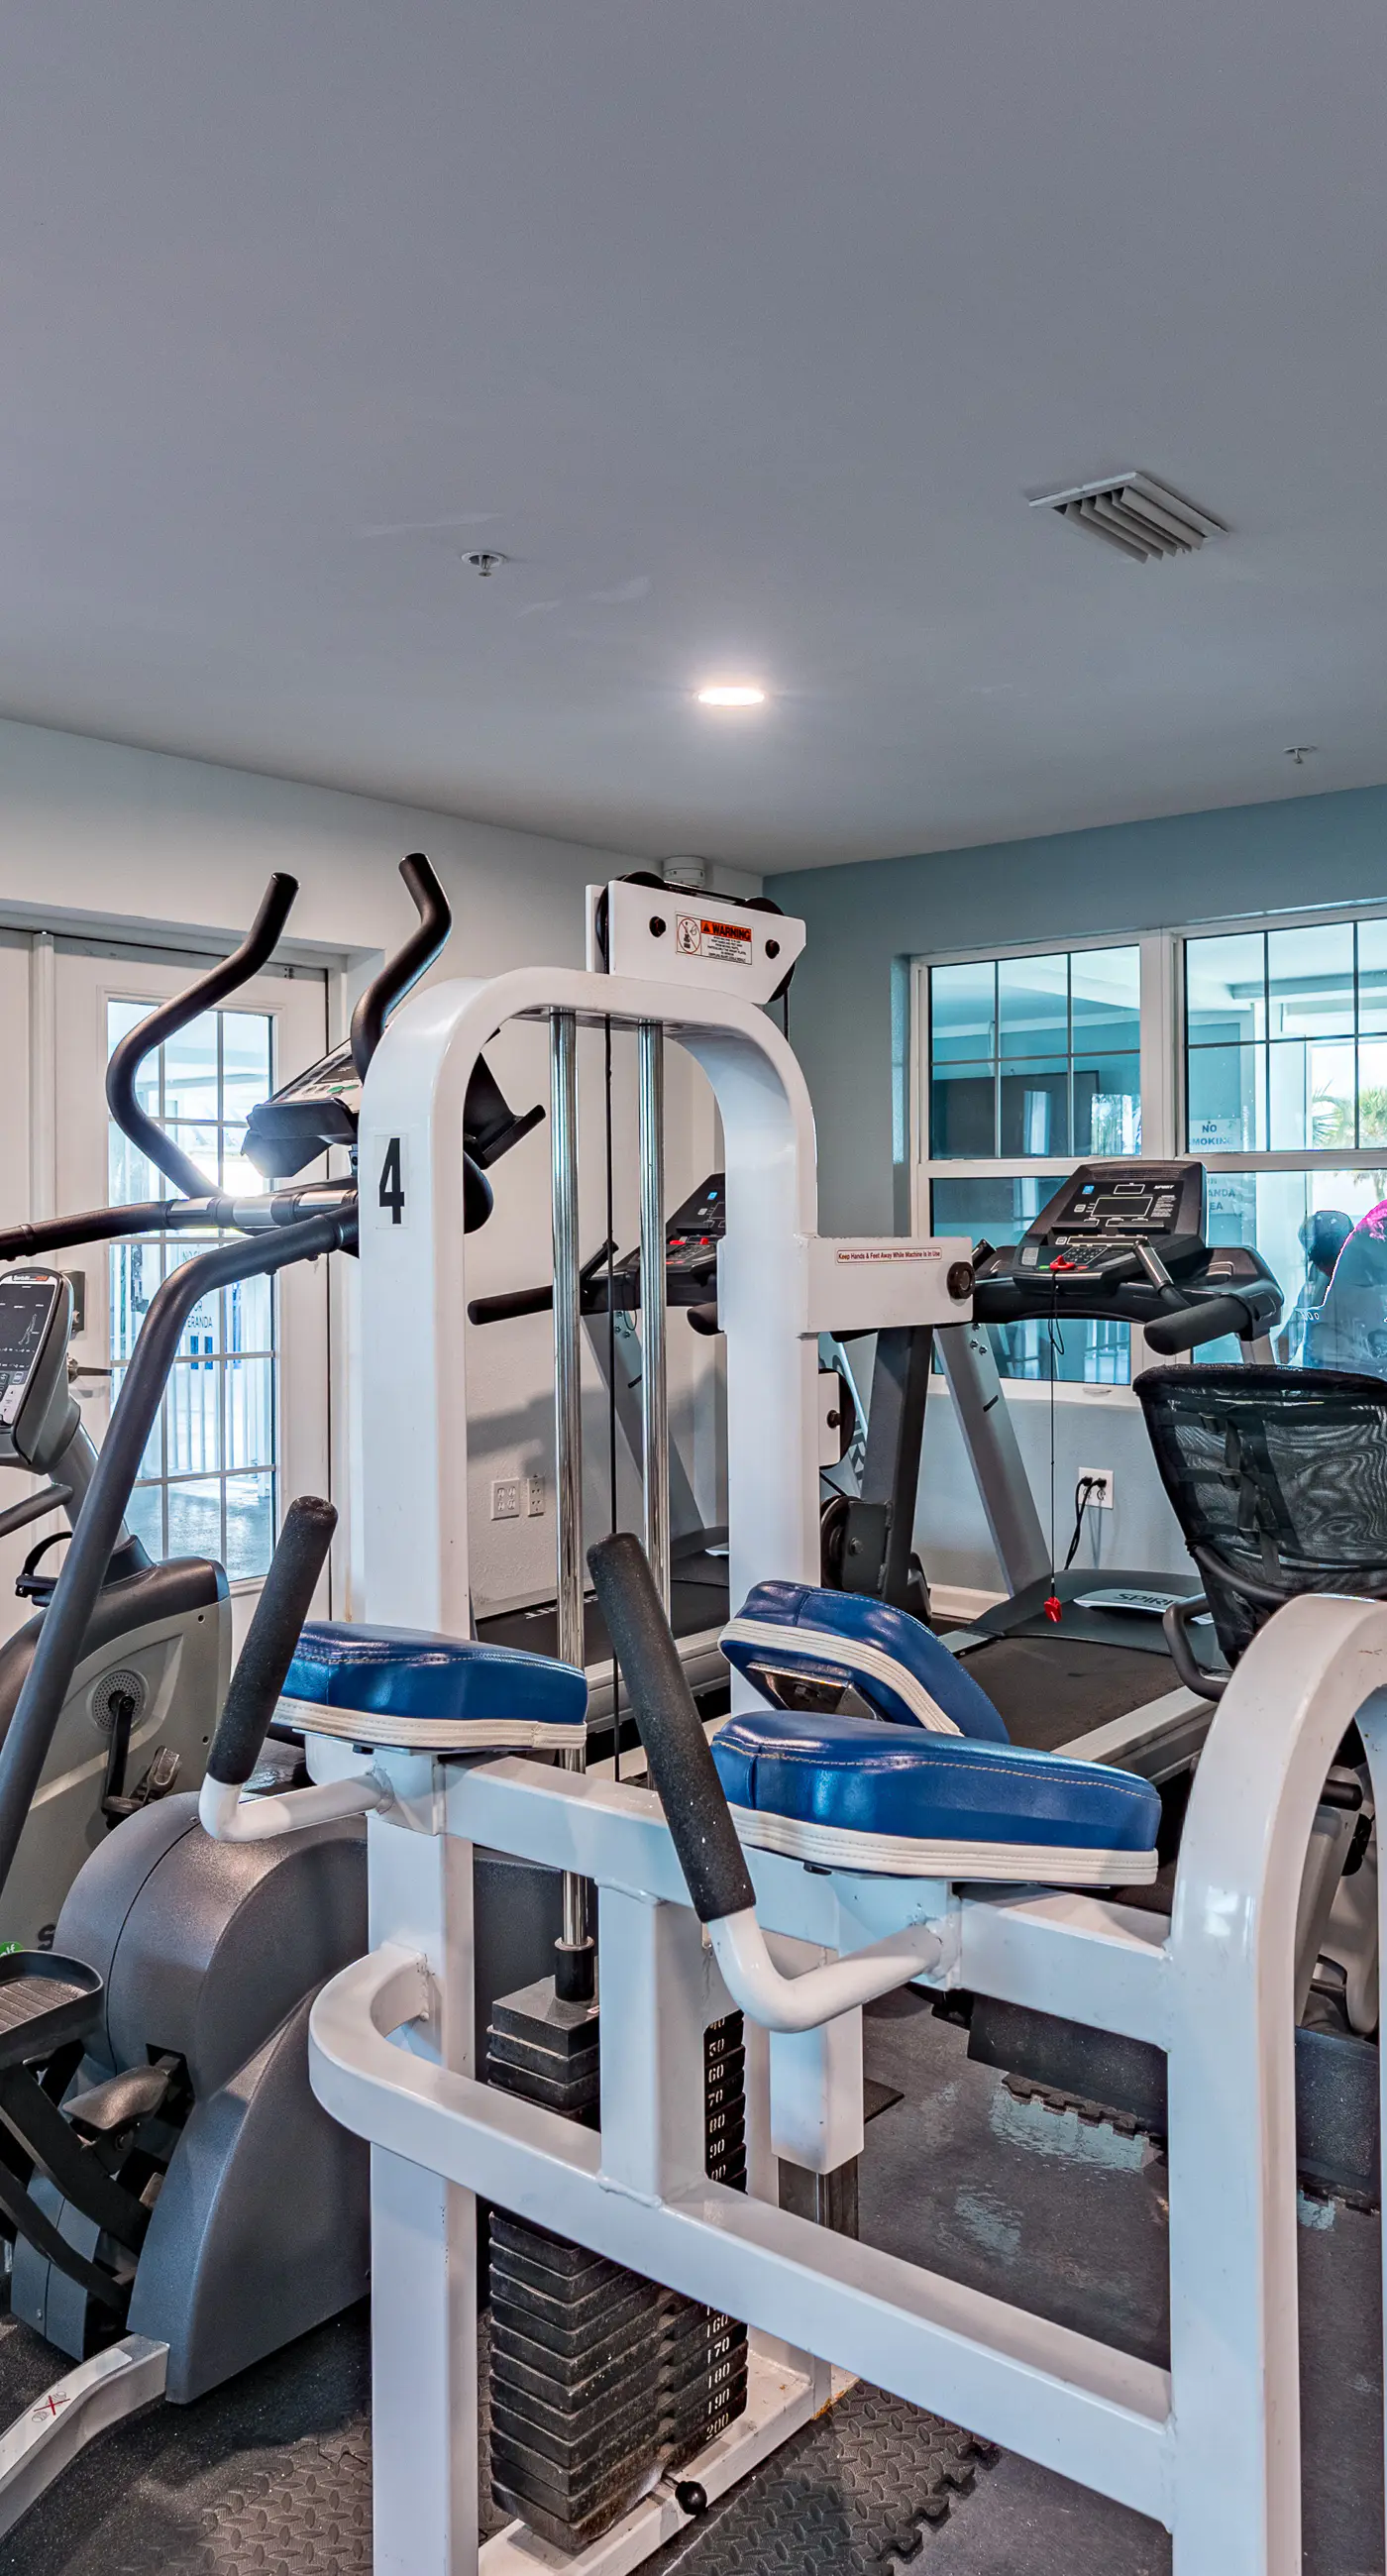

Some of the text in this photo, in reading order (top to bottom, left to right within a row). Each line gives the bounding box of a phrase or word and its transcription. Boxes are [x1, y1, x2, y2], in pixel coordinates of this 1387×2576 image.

[712, 923, 750, 940] WARNING
[1202, 1125, 1218, 1133] NO
[1191, 1136, 1233, 1145] MOKING
[378, 1137, 405, 1225] 4
[1208, 1188, 1236, 1198] ANDA
[1209, 1201, 1224, 1211] EA
[187, 1315, 213, 1329] ERANDA
[1115, 1593, 1177, 1606] SPIRI
[708, 2038, 725, 2057] 50
[707, 2064, 724, 2084] 60
[707, 2089, 724, 2107] 70
[708, 2113, 725, 2133] 80
[709, 2138, 725, 2159] 90
[706, 2313, 729, 2338] 160
[706, 2336, 730, 2364] 170
[707, 2362, 730, 2390] 180
[707, 2388, 730, 2415] 190
[705, 2412, 729, 2441] 200
